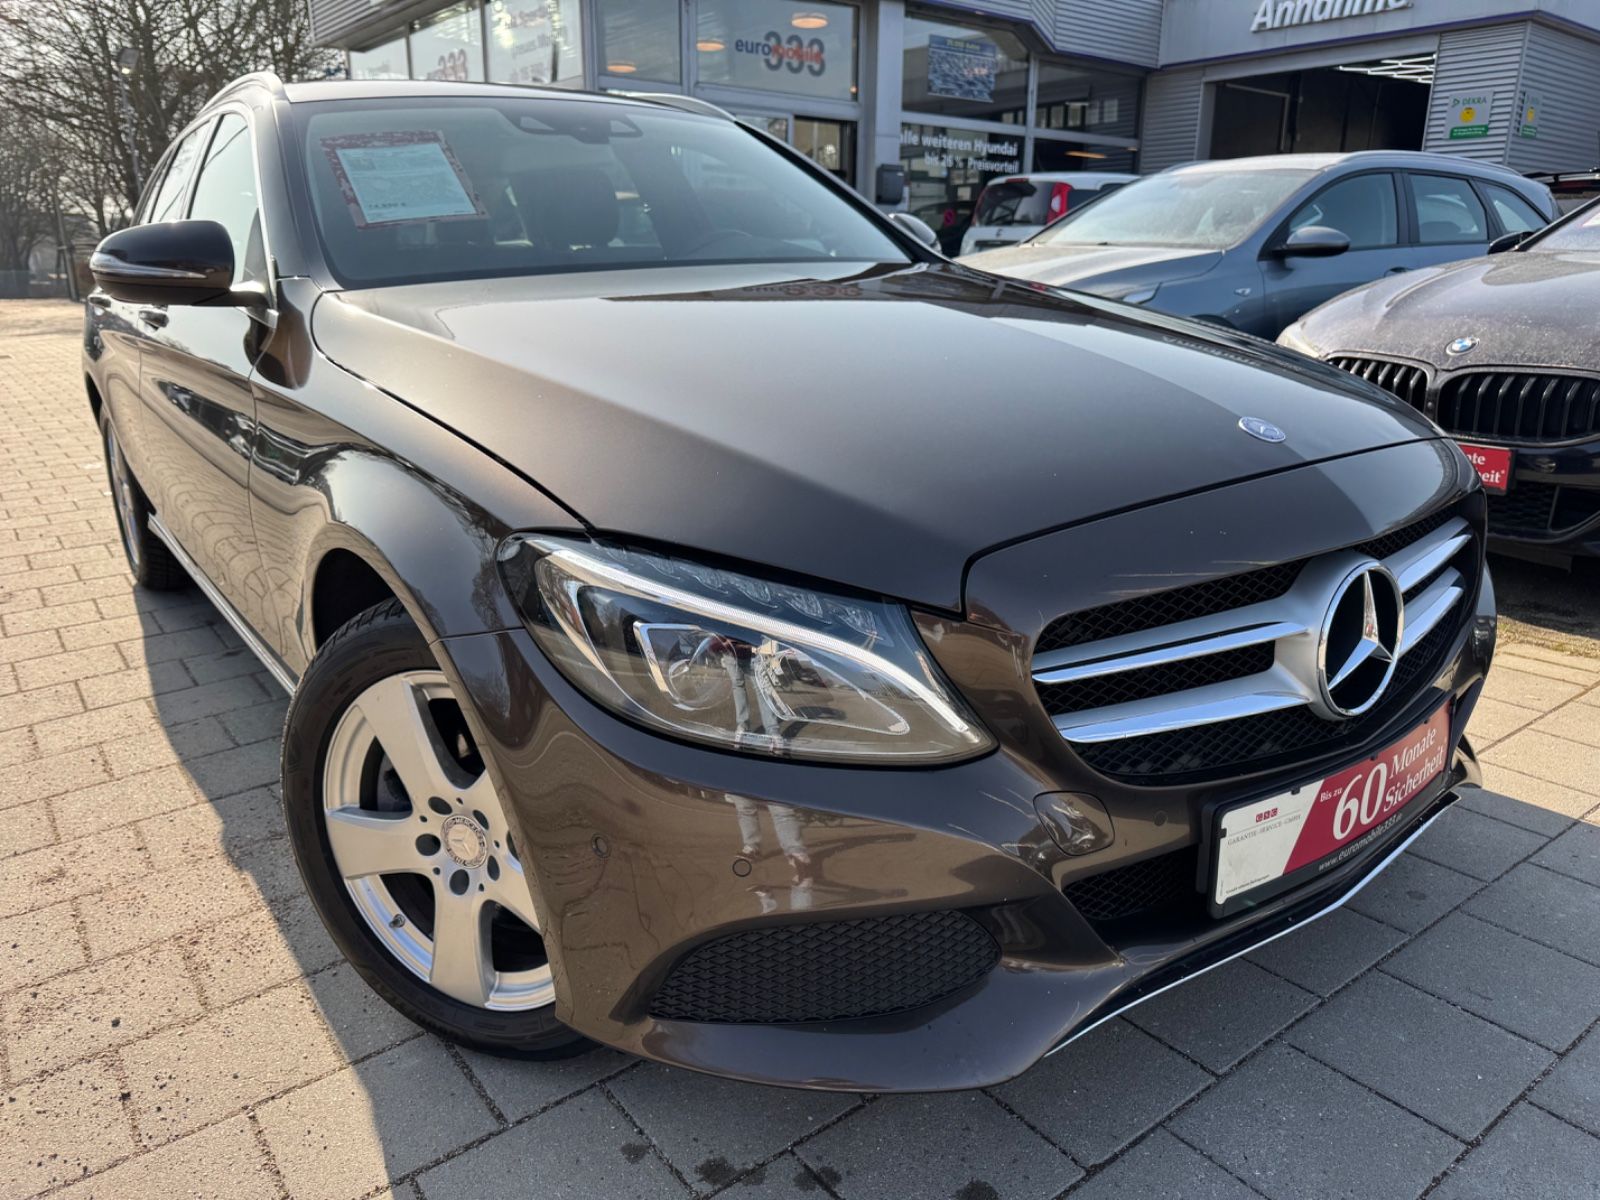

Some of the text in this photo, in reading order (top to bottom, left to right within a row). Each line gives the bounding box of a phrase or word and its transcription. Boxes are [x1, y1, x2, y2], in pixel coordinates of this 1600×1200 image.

[764, 31, 826, 77] 333
[921, 134, 972, 152] weiteren
[974, 139, 1018, 157] Hyundai
[924, 151, 939, 167] bis
[967, 157, 1020, 174] Preisvorteil
[1388, 728, 1437, 780] Monate
[1320, 745, 1445, 841] Bis zu 60 Sicherheit
